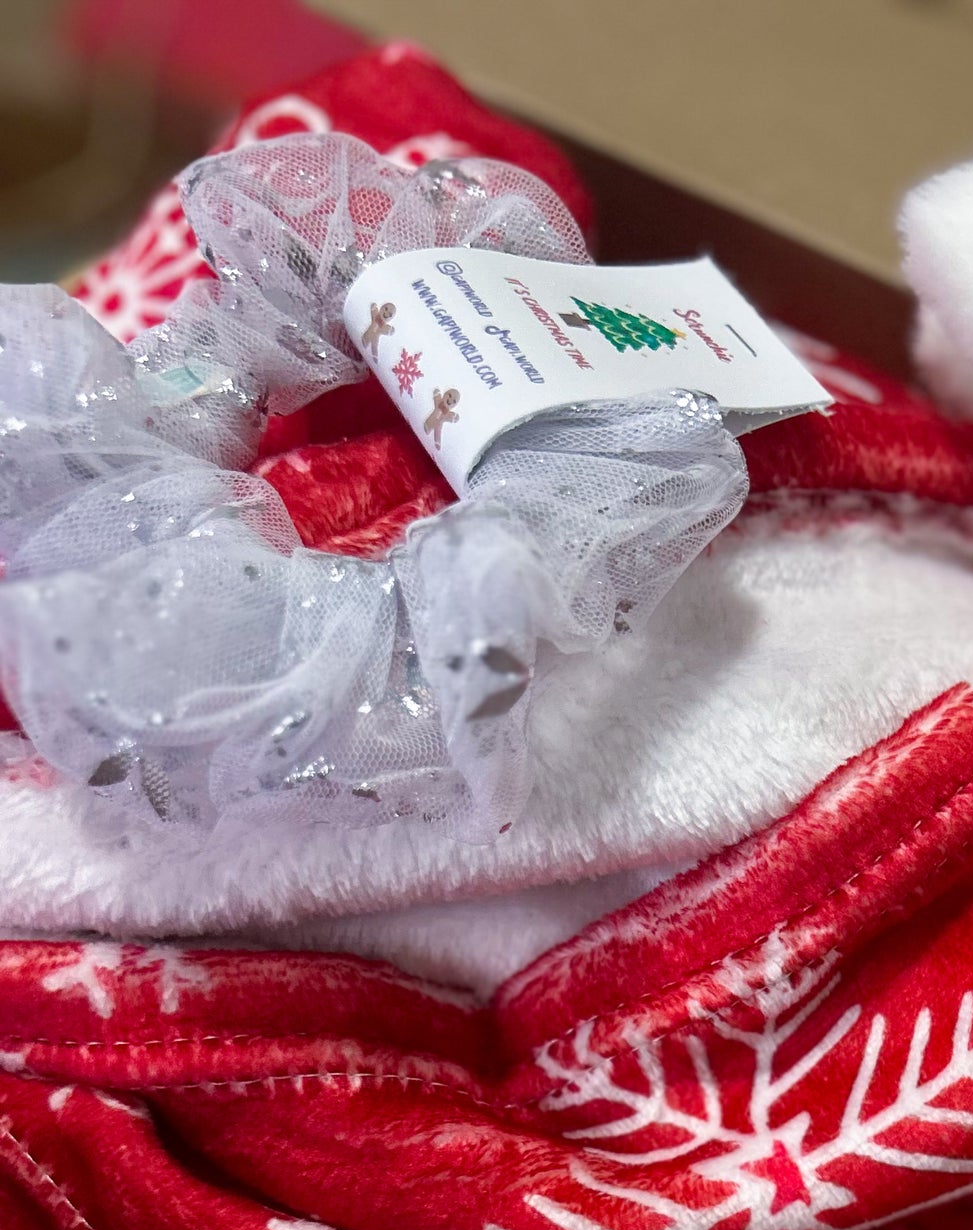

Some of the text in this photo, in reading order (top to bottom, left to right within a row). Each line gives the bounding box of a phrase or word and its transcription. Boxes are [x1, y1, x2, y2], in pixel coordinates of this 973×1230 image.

[411, 279, 502, 390] WWW.GAPIWORLD.COM
[503, 277, 595, 370] IT'S CHRISTMAS TIME
[673, 309, 733, 363] Scrunchie
